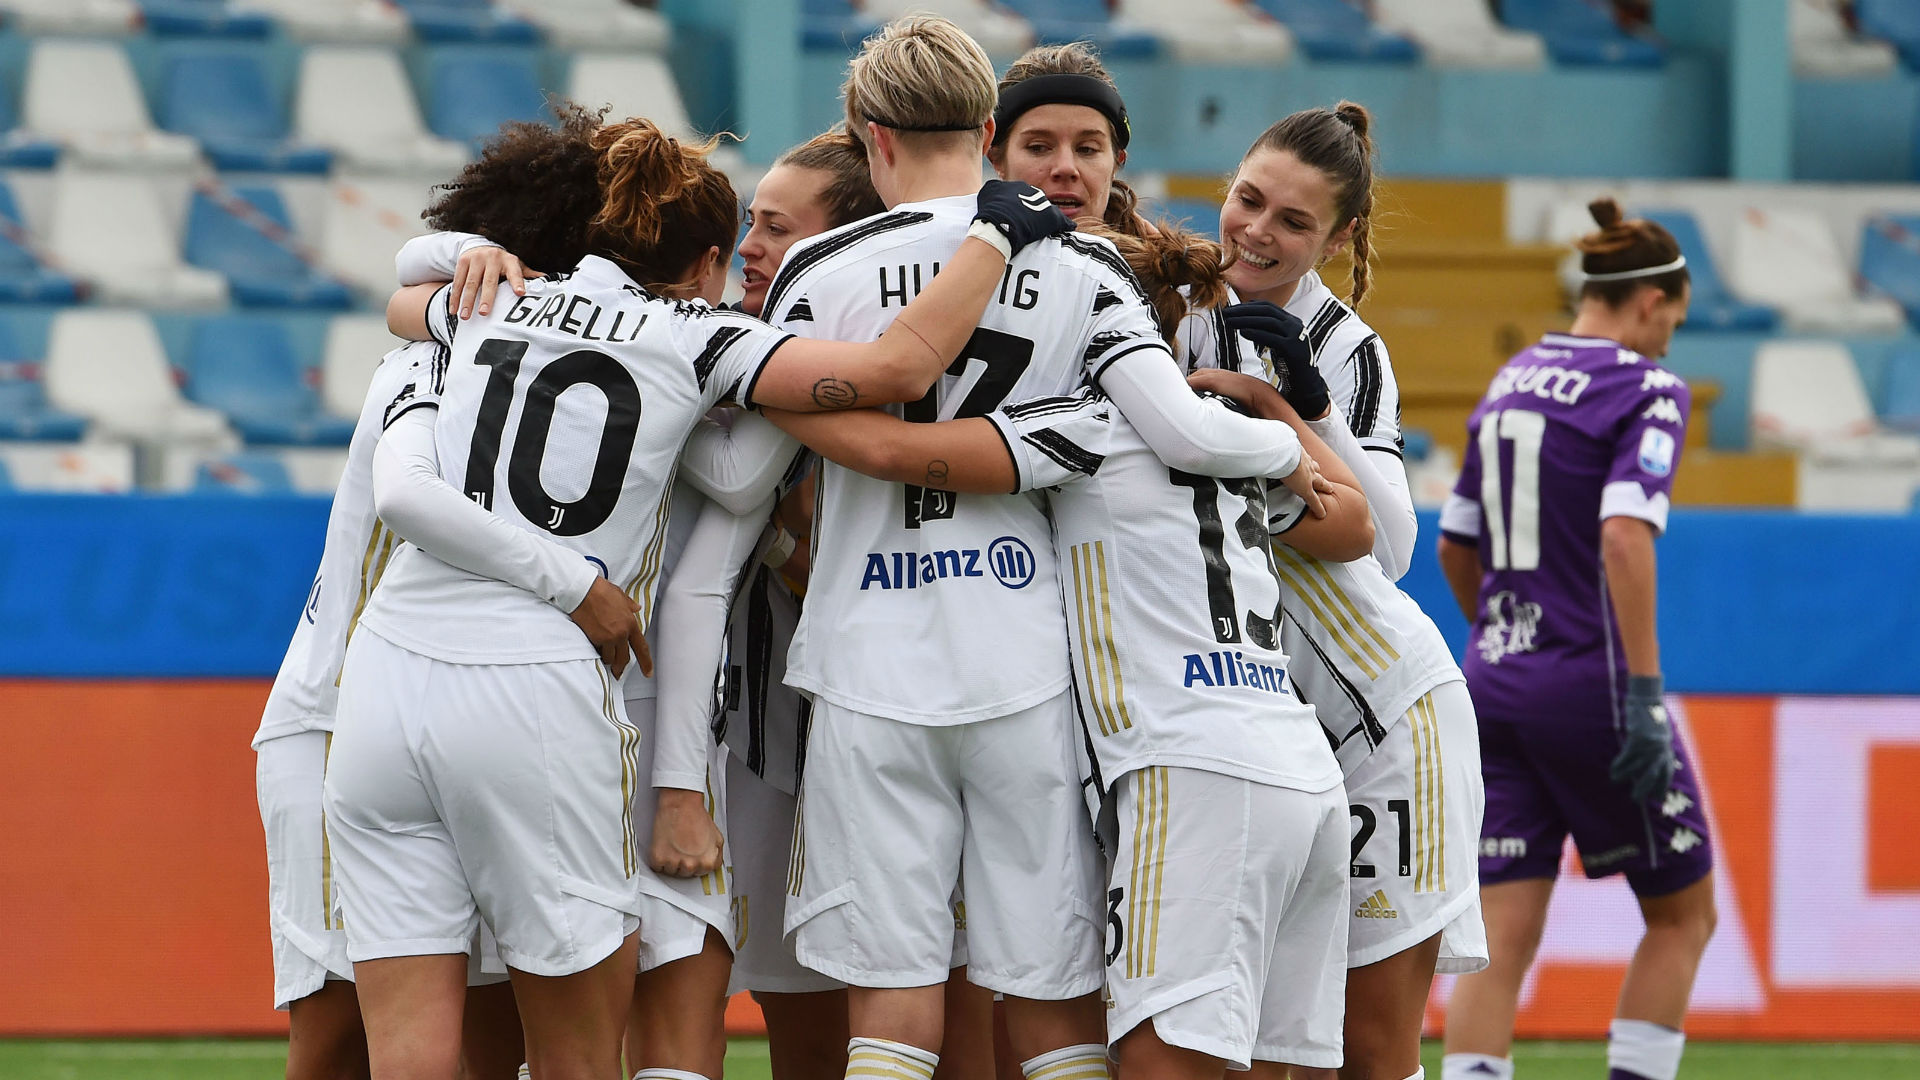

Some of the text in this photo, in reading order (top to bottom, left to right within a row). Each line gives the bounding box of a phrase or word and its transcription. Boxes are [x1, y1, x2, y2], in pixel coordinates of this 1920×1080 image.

[504, 293, 648, 342] GIRELLI
[879, 262, 1041, 311] HUIG
[463, 338, 642, 537] 10
[1478, 409, 1546, 570] 11
[860, 549, 983, 590] Allanz
[1169, 466, 1284, 651] 13
[1183, 651, 1290, 694] Allianz
[1350, 800, 1411, 878] 21
[1105, 887, 1123, 967] 3
[1354, 907, 1398, 919] adidas
